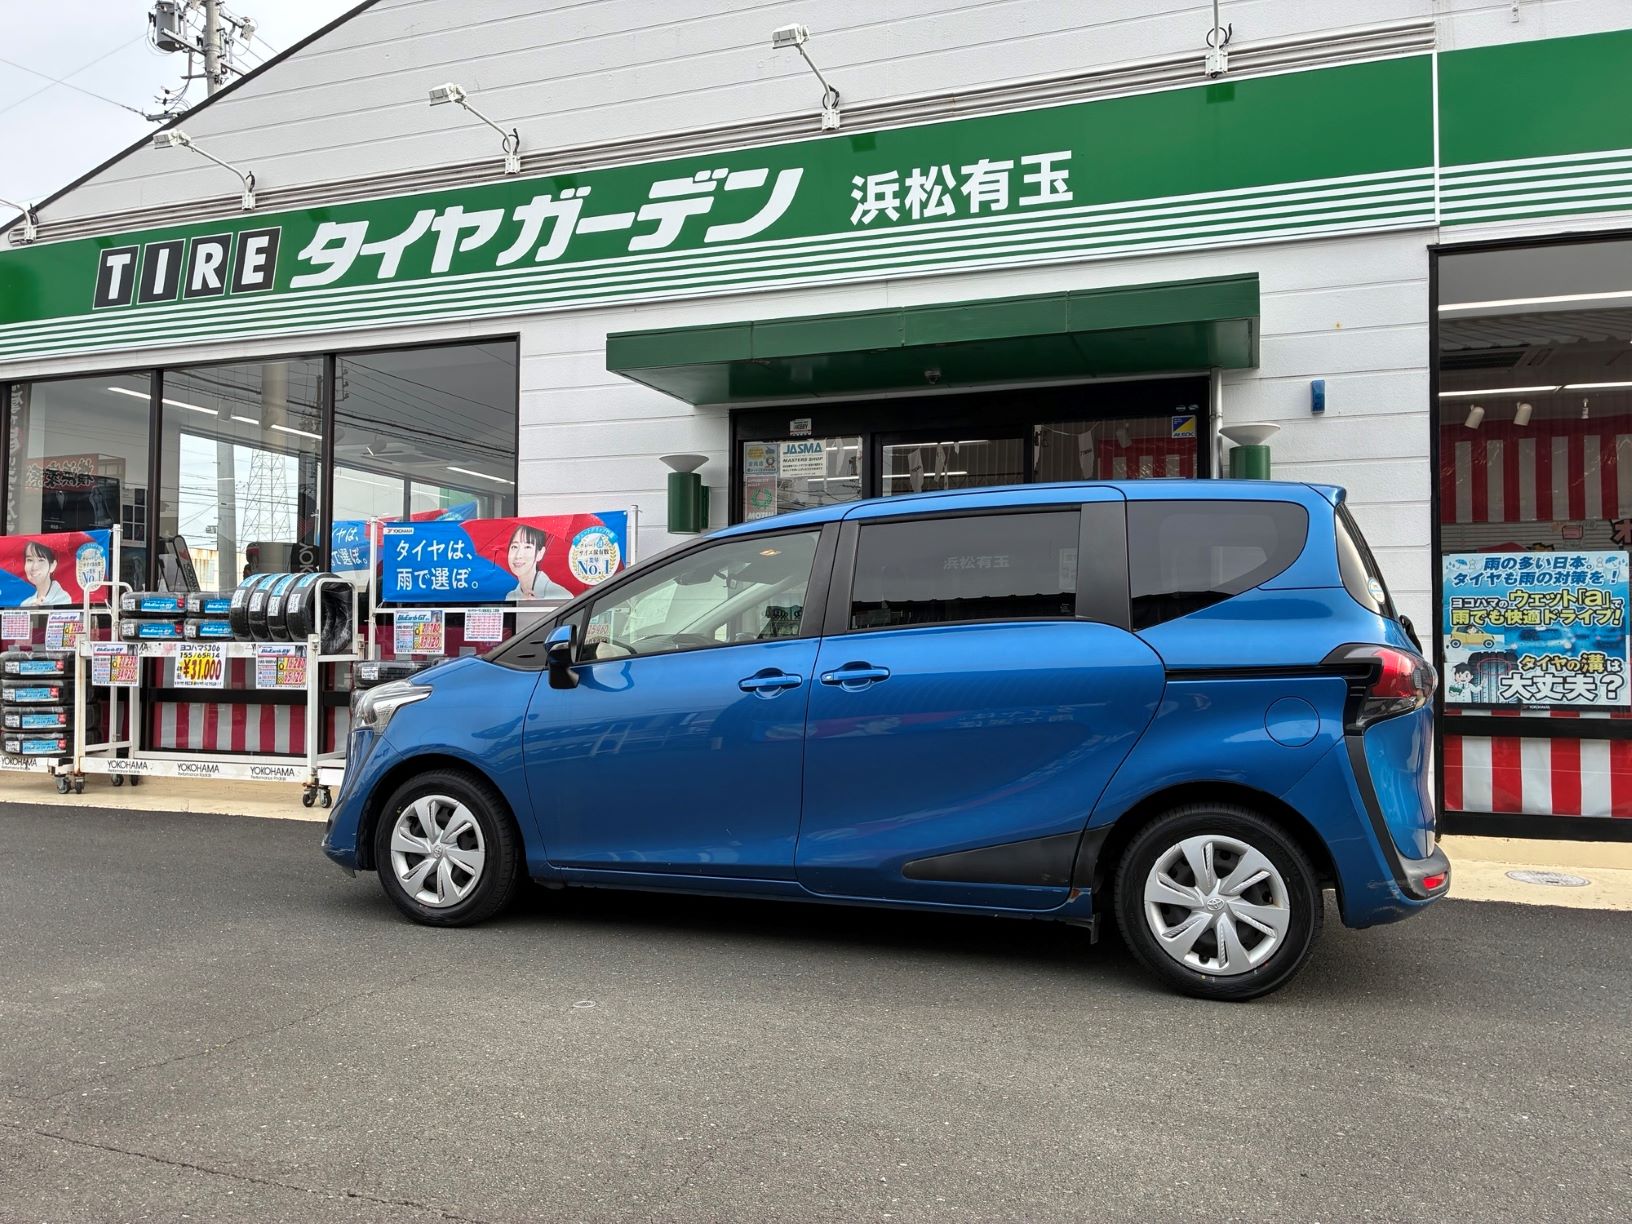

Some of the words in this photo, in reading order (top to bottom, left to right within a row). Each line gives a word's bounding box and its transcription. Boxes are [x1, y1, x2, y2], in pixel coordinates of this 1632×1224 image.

[849, 150, 1074, 226] 浜松有玉
[289, 166, 804, 290] タイヤガーデン
[102, 233, 273, 305] TIRE
[783, 442, 823, 454] JASMA
[396, 539, 473, 562] タイヤは、
[1483, 555, 1593, 571] 雨の多い日本。
[396, 567, 479, 591] 雨で選ぼ。
[1519, 652, 1623, 673] タイヤの溝は
[107, 760, 148, 770] YOKOHAMA
[177, 763, 220, 773] YOKOHAMA
[250, 766, 295, 776] YOKOHAMA
